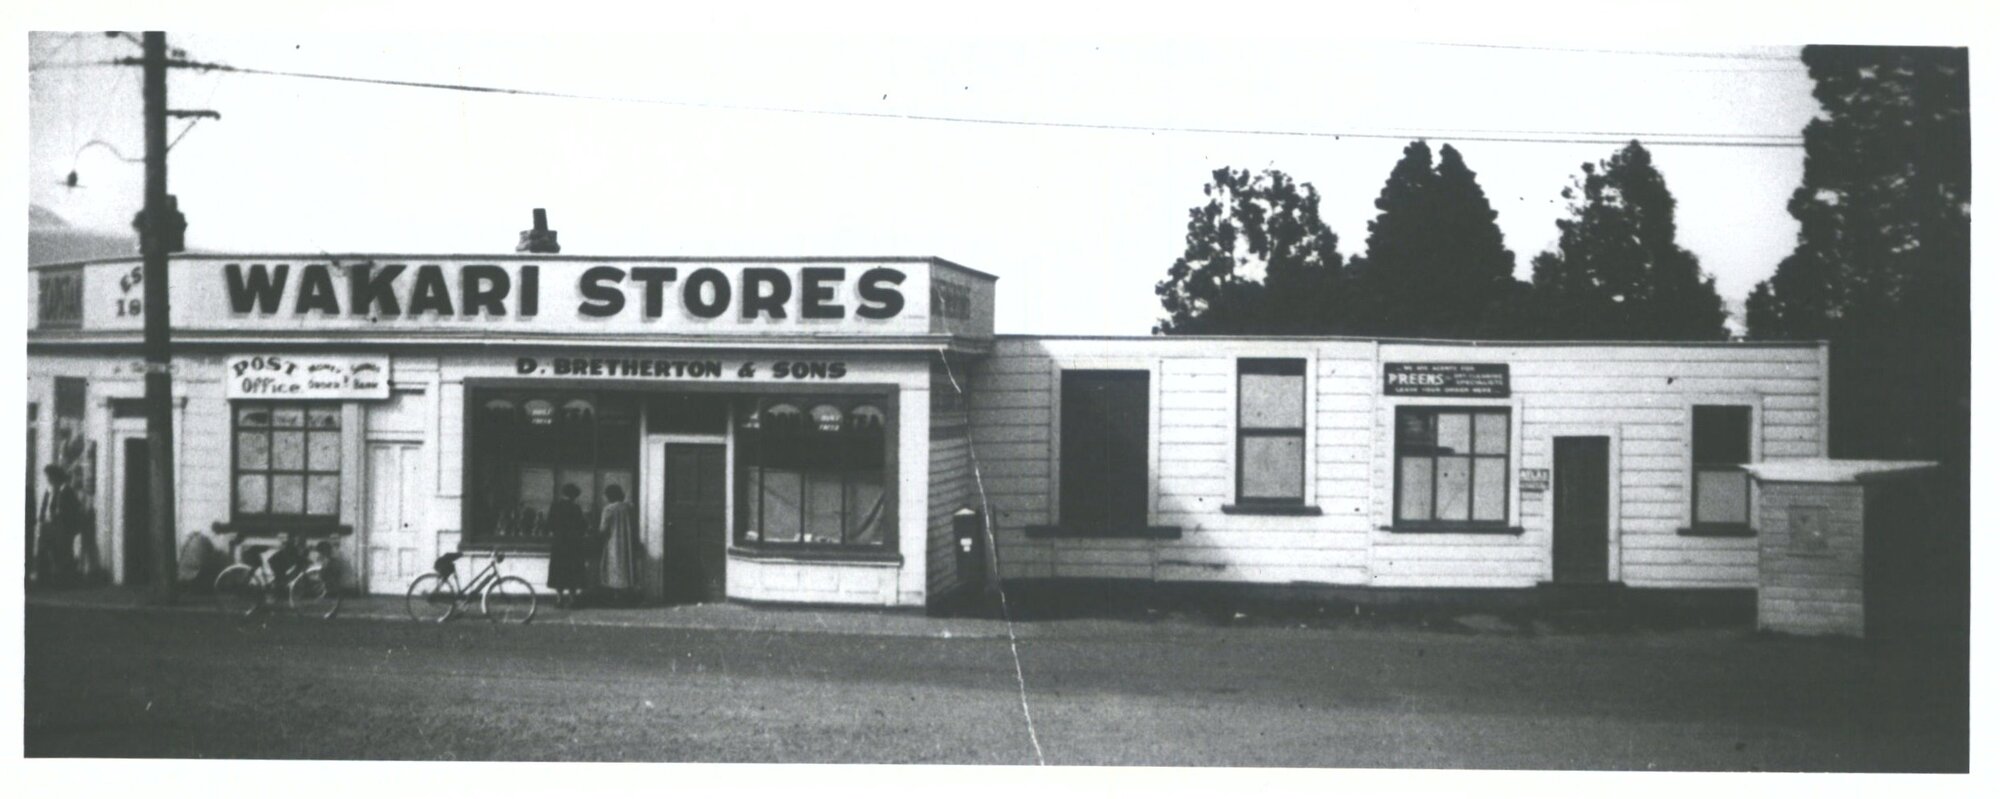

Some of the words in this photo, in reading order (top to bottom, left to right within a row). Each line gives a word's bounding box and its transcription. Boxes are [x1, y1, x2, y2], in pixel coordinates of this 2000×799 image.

[224, 263, 540, 317] WAKARI
[576, 265, 907, 320] STORES
[233, 356, 297, 377] POST
[515, 357, 546, 375] D.
[553, 357, 723, 379] BRETHERTON
[737, 361, 757, 378] &
[771, 360, 848, 380] SONS
[241, 376, 300, 394] Office
[1388, 372, 1445, 385] PREENS
